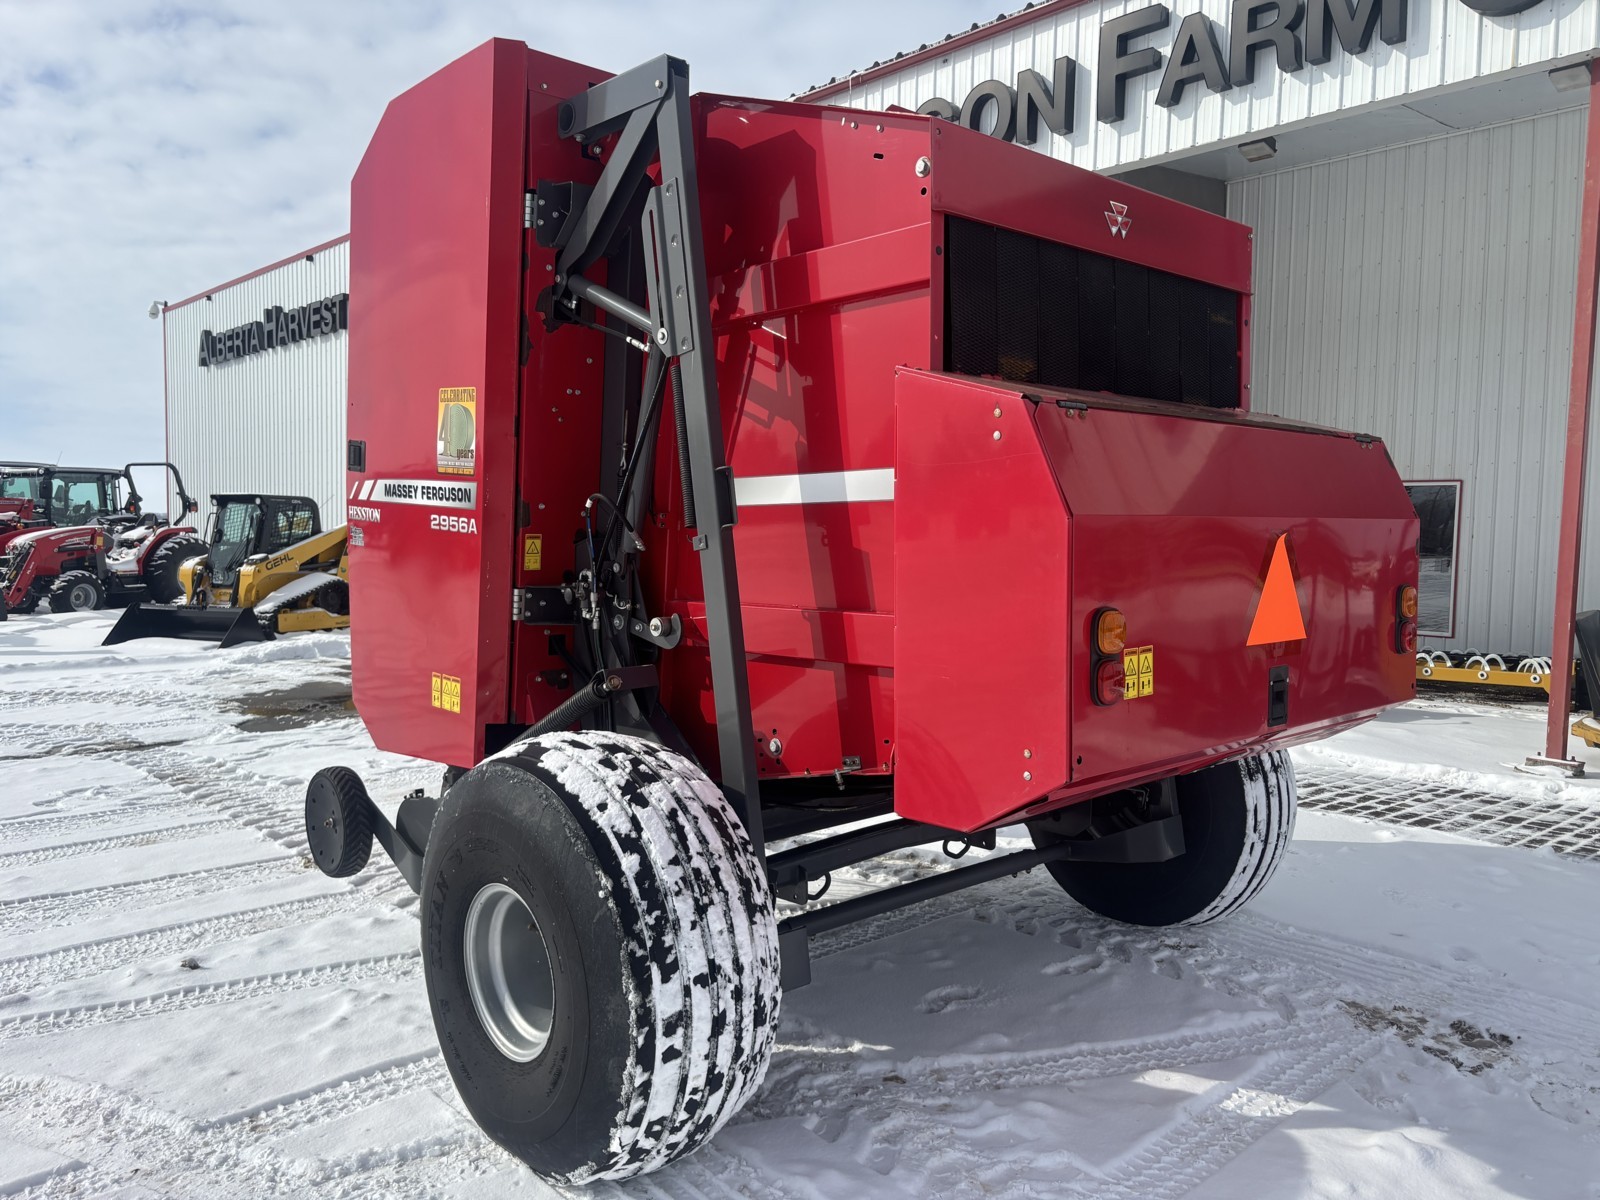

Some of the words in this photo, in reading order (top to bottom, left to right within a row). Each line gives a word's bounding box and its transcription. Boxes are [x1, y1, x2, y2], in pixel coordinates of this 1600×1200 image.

[1097, 0, 1406, 124] FARM
[199, 321, 264, 367] ALBERTA
[263, 293, 349, 350] HARVEST
[440, 389, 475, 403] CELEBRATING
[457, 449, 475, 460] years
[384, 483, 418, 500] MASSEY
[421, 486, 471, 503] FERGUSON
[348, 505, 381, 523] HESSTON
[430, 514, 478, 535] 2956A
[265, 553, 294, 571] GEHL
